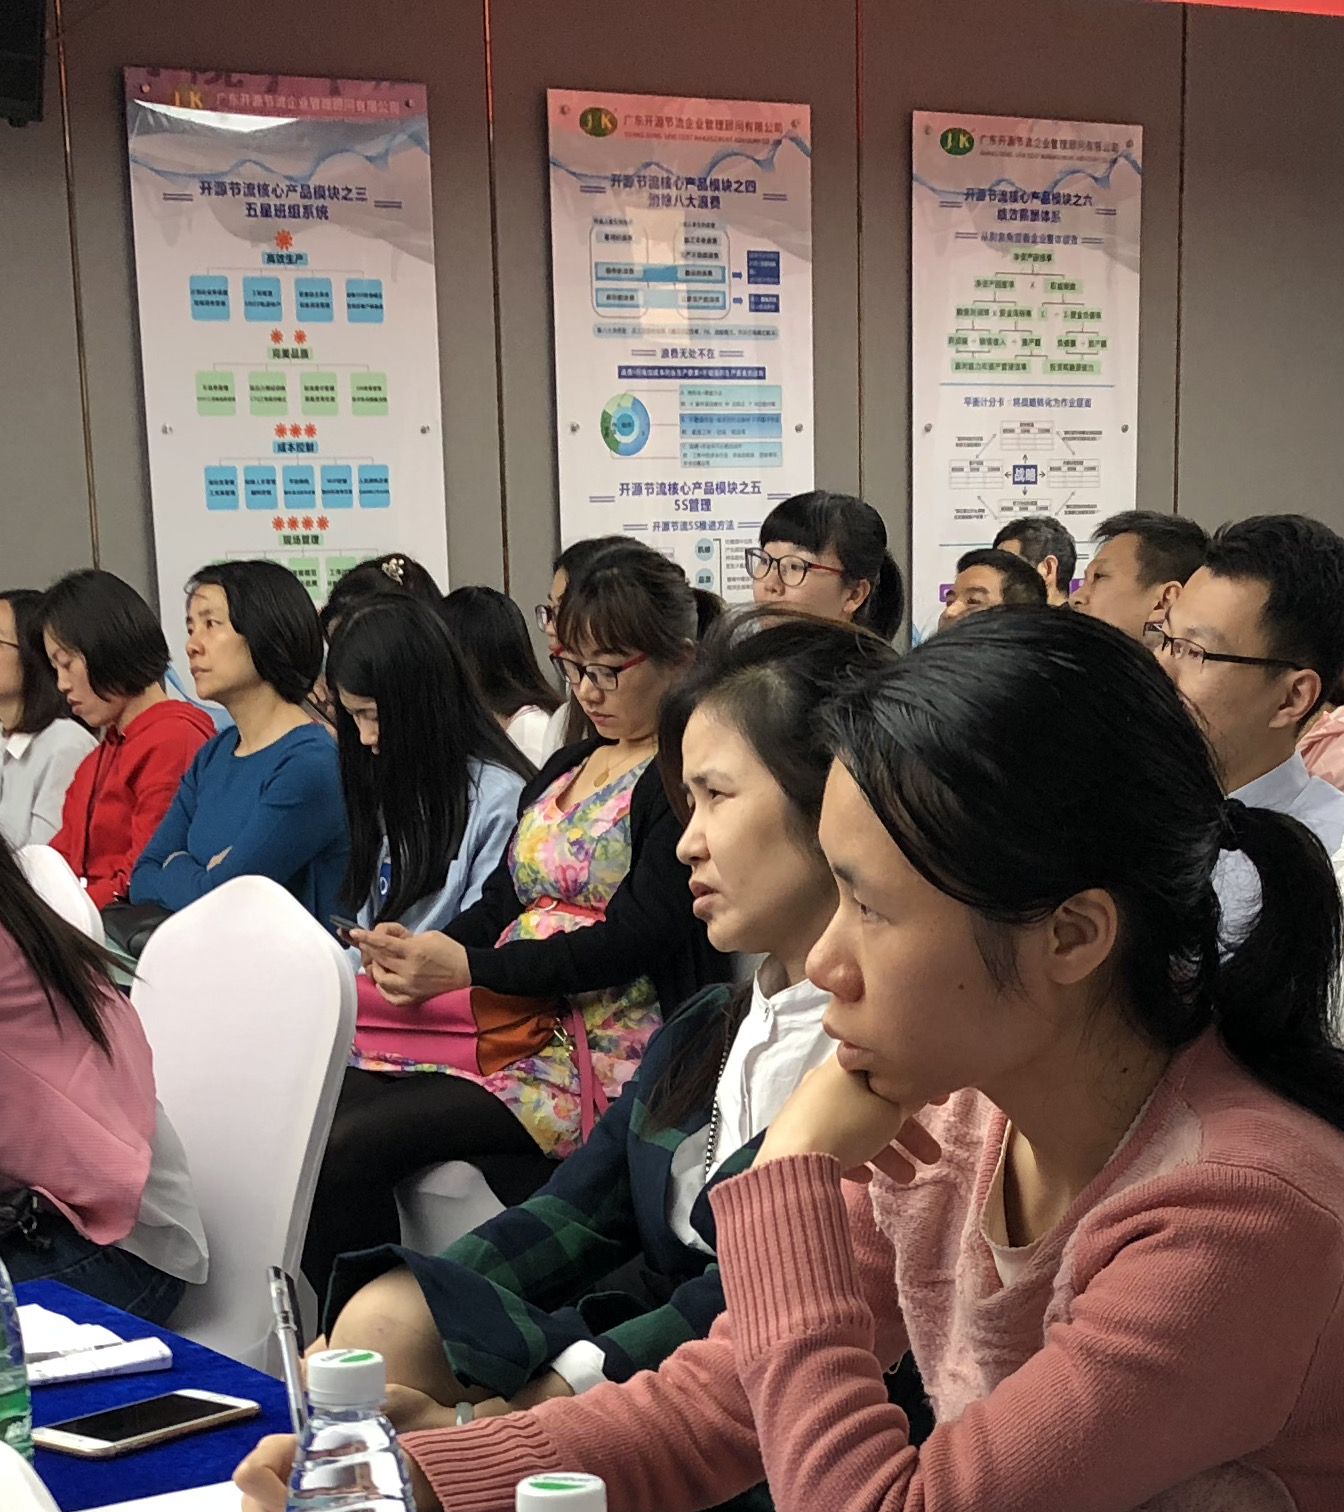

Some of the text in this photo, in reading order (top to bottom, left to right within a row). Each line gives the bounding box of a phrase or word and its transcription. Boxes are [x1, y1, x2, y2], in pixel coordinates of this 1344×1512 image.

[199, 180, 368, 202] 开源节流核心产品模块之三
[245, 202, 329, 221] 五星班组系统
[618, 481, 762, 497] 开源节流核心产品模块之五
[674, 499, 712, 512] 5S管理
